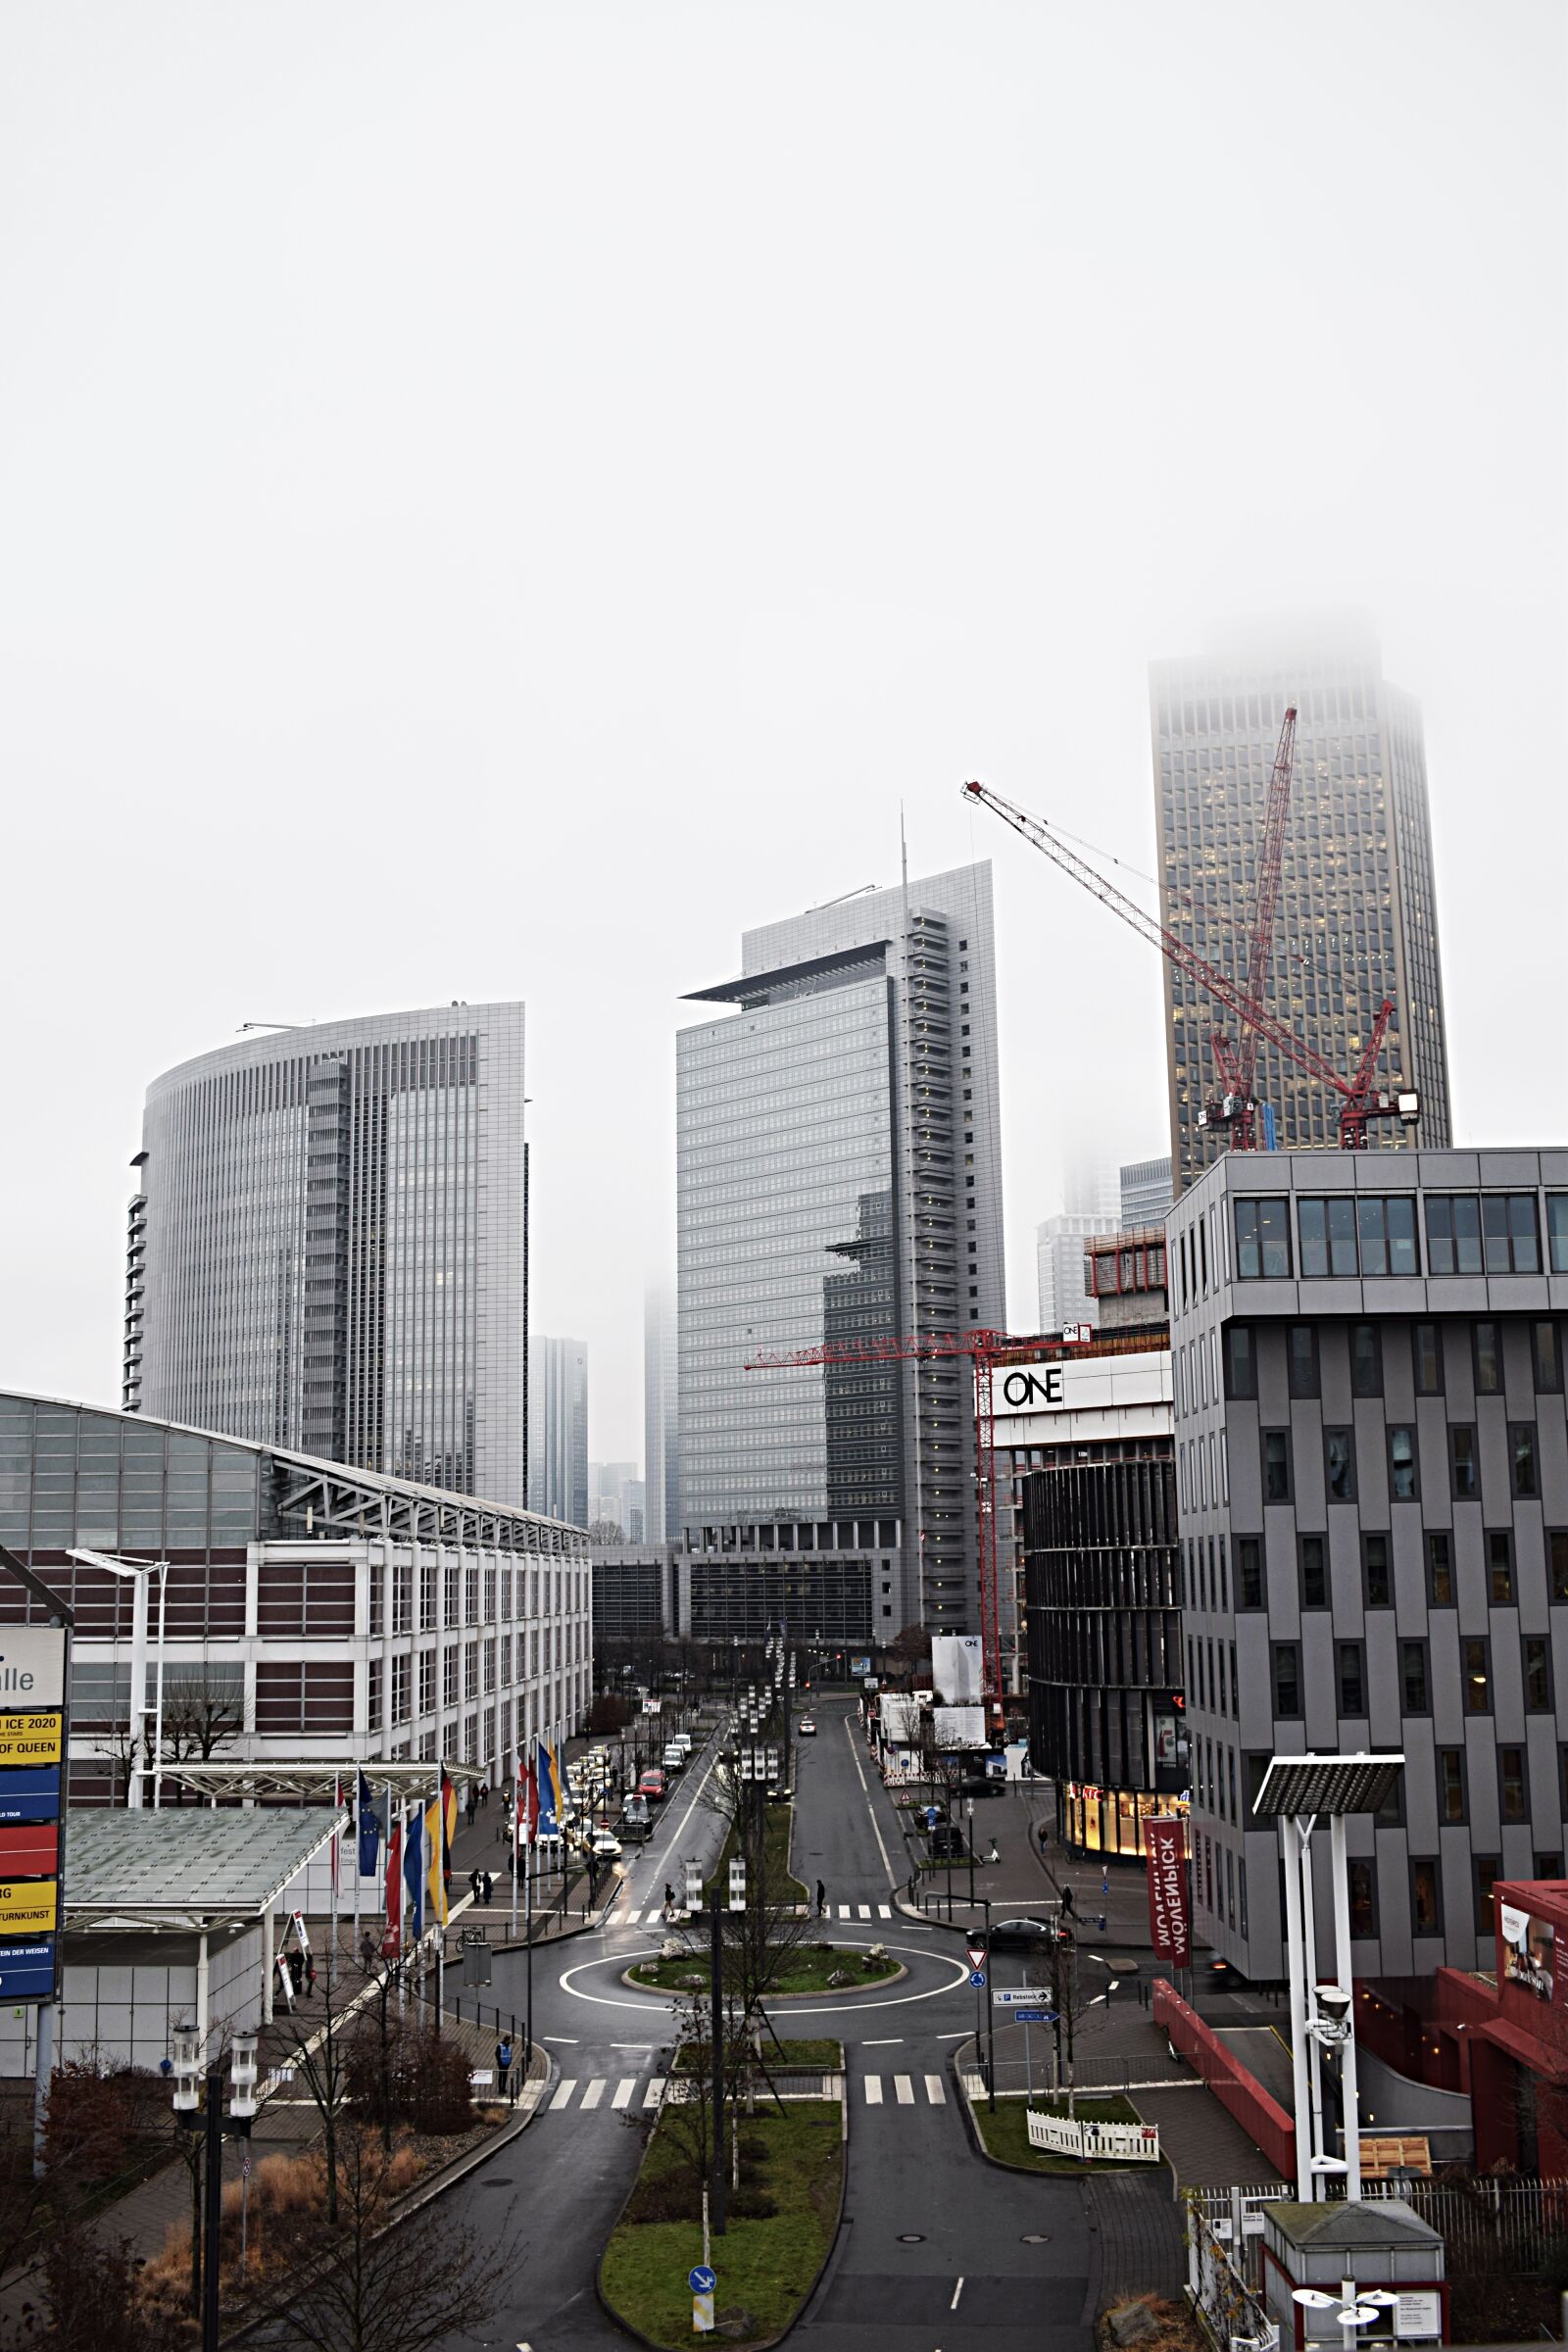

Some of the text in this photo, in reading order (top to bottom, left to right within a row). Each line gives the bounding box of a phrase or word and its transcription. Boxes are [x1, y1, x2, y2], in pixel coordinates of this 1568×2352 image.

[1063, 1326, 1077, 1335] ONE
[1004, 1368, 1062, 1406] ONE
[0, 1667, 34, 1690] lle
[6, 1719, 24, 1730] ICE
[27, 1717, 57, 1729] 2020
[0, 1742, 56, 1754] OF QUEEN
[1082, 1787, 1103, 1801] KFC
